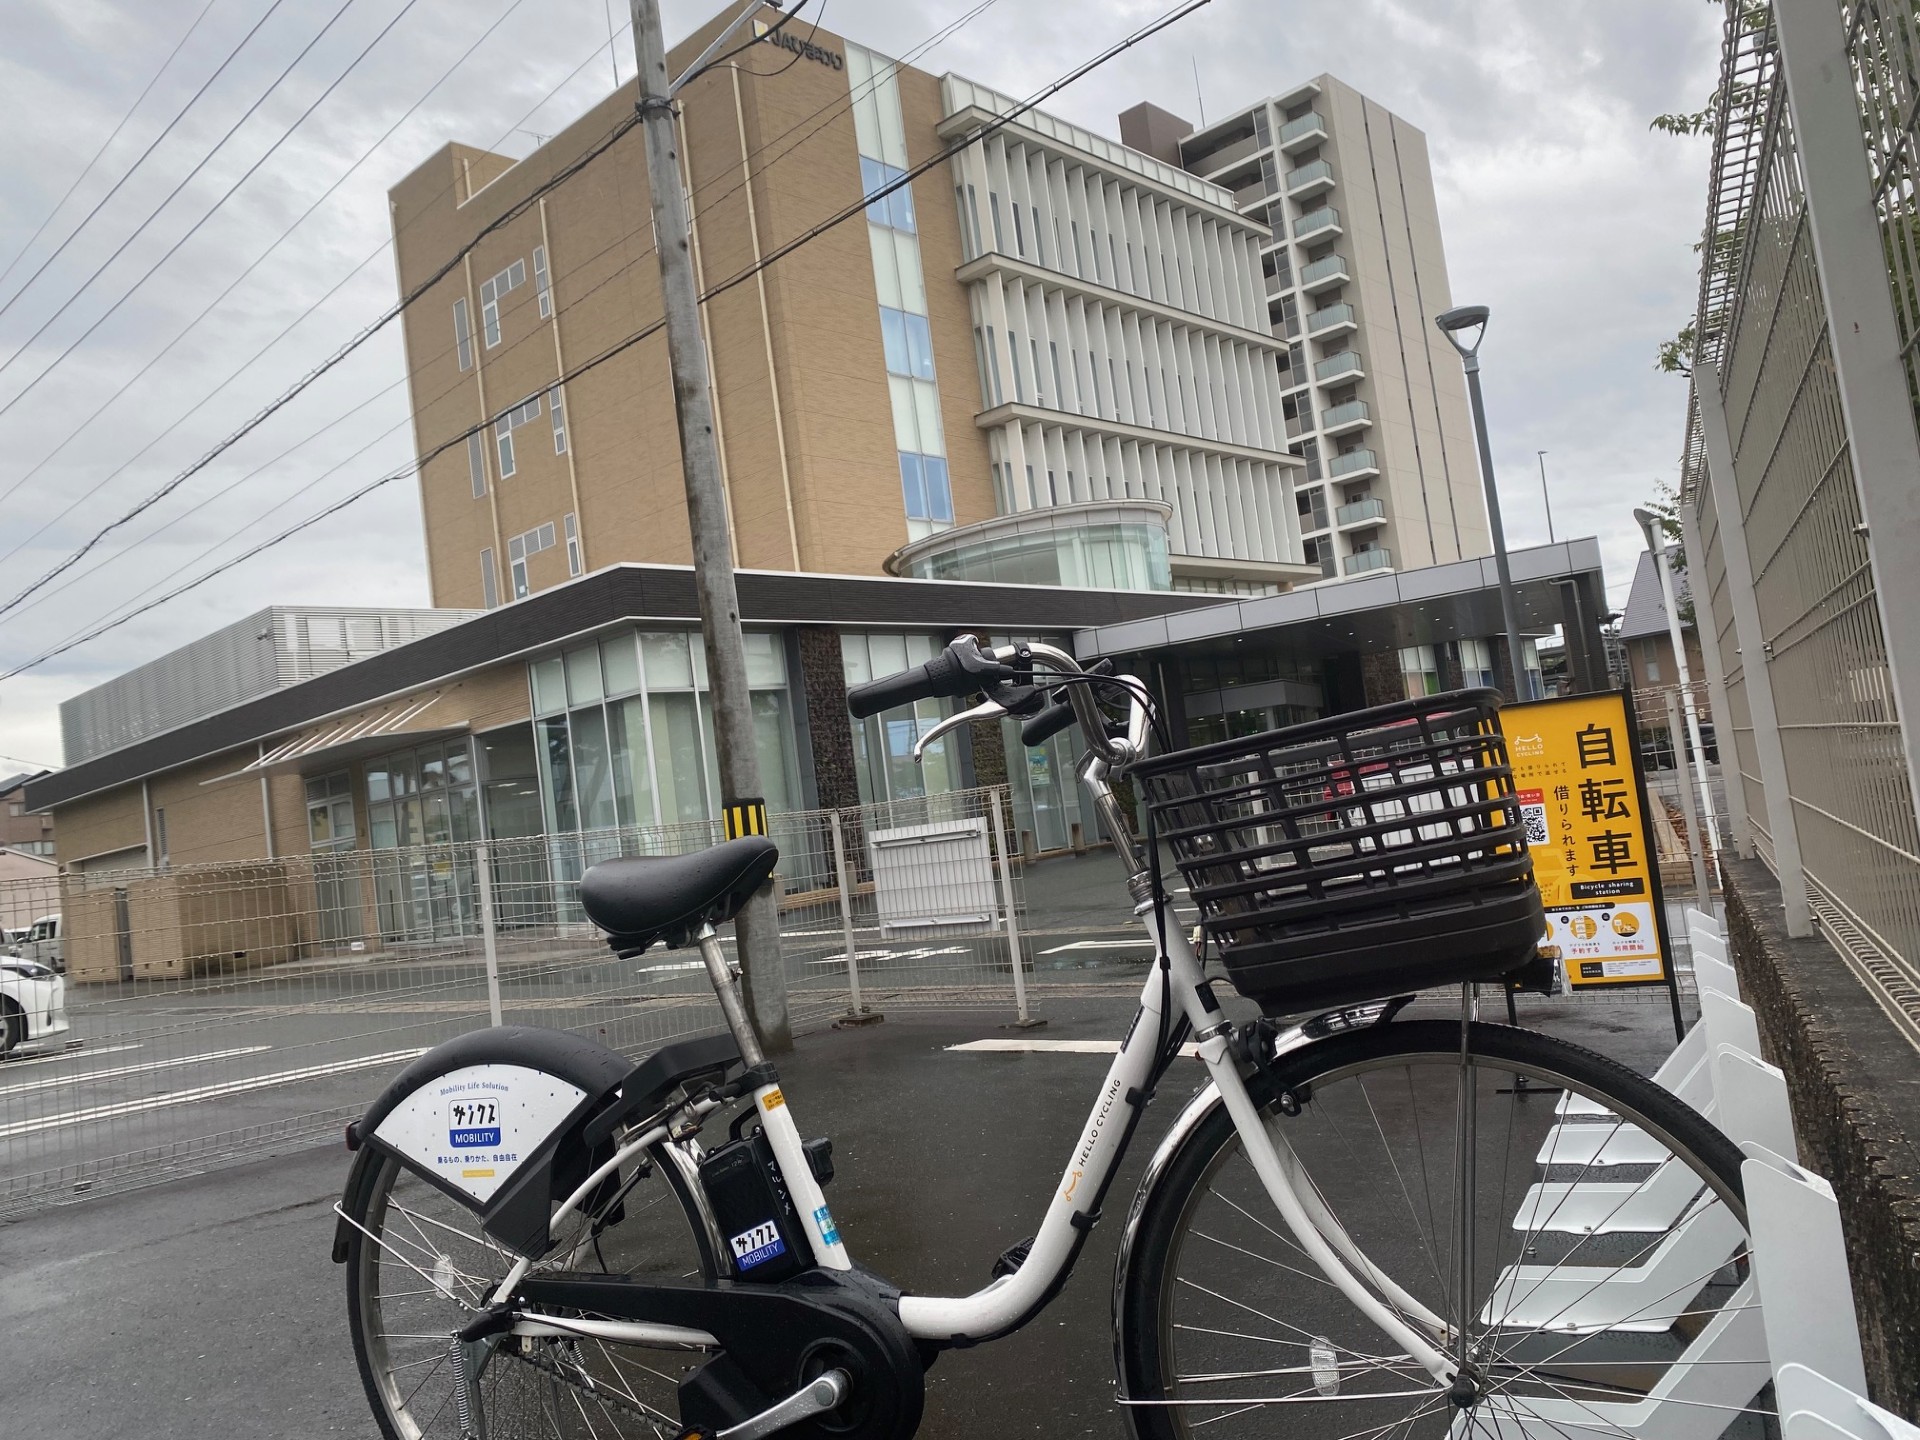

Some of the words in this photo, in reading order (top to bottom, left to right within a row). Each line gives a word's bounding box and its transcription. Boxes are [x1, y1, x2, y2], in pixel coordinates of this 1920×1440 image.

[1515, 743, 1543, 752] HELLO
[1516, 750, 1544, 758] CYCLING
[1575, 723, 1638, 875] 自転車
[1553, 785, 1580, 877] 借りられます
[1580, 882, 1605, 891] Bicycle
[1608, 880, 1634, 889] sharing
[1595, 888, 1621, 896] station
[1571, 946, 1600, 955] 予約する
[440, 1083, 466, 1096] Mobility
[467, 1082, 480, 1090] Life
[481, 1082, 509, 1092] Solution
[1078, 1129, 1099, 1168] HELLO
[1096, 1079, 1121, 1127] CYCLING
[455, 1132, 495, 1144] MOBILITY
[741, 1242, 779, 1267] MOBILITY
